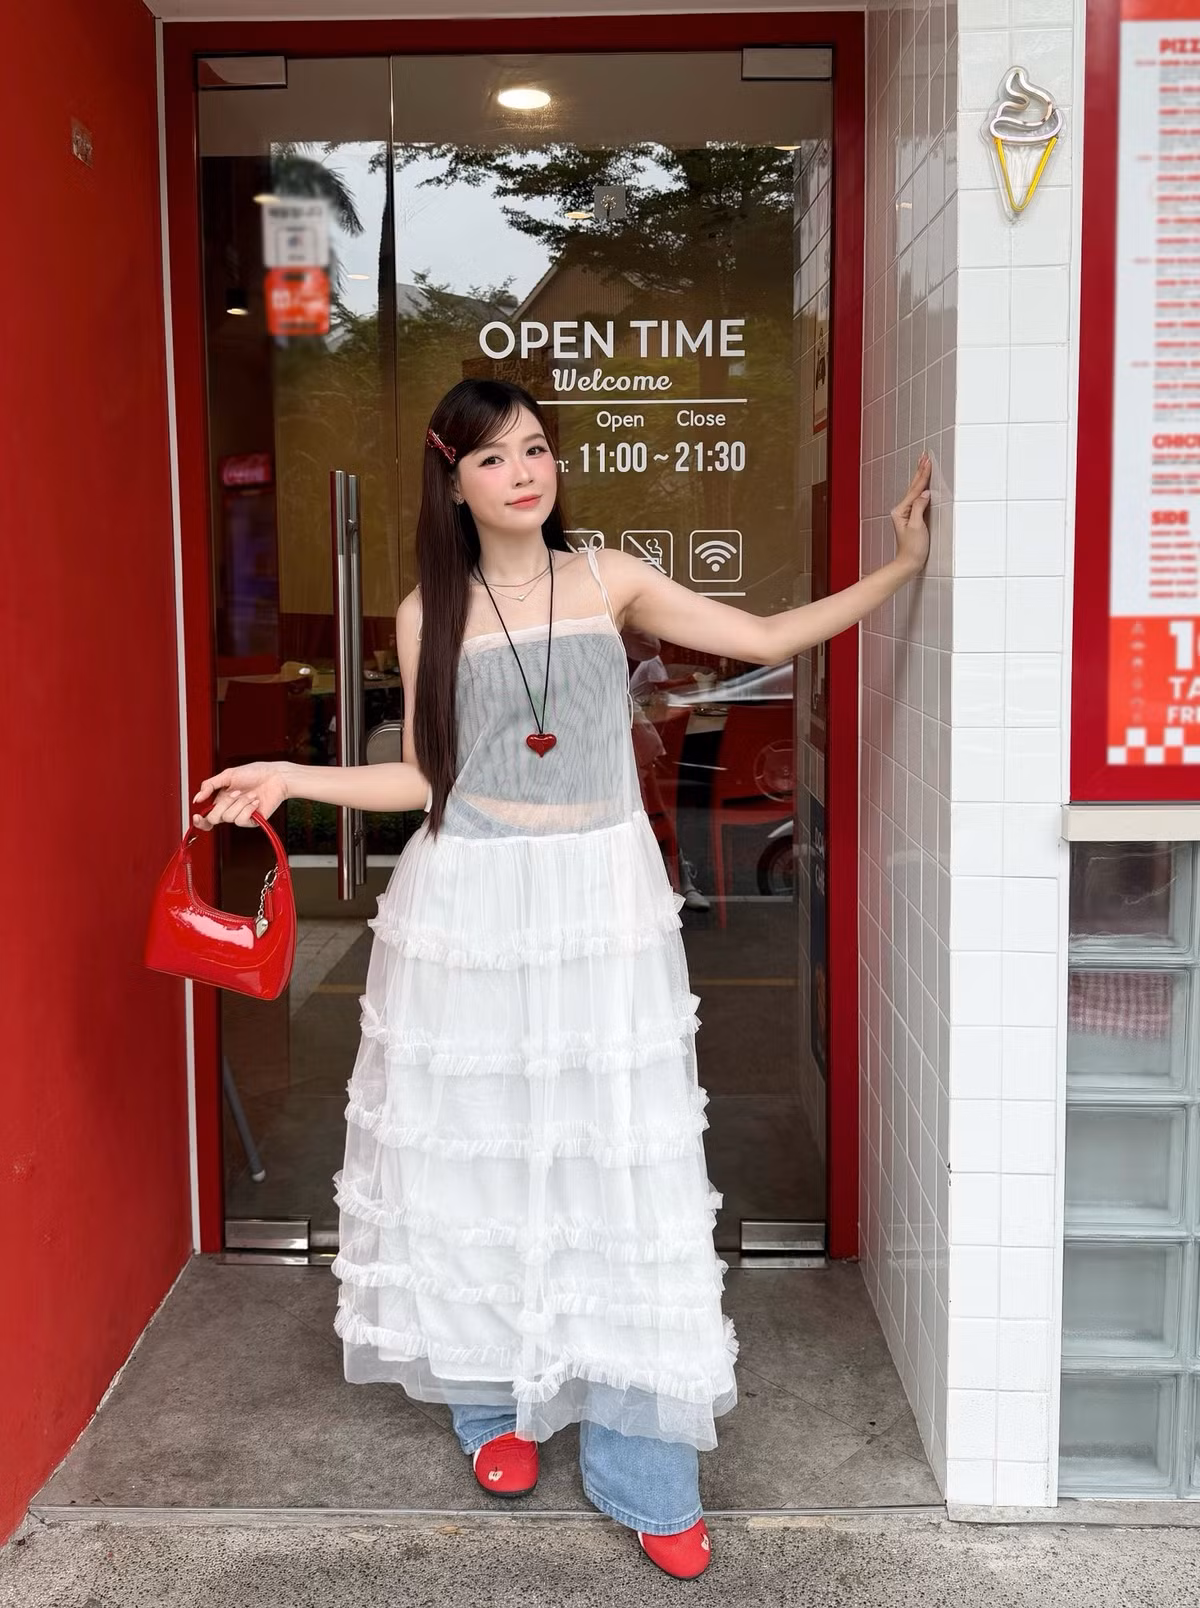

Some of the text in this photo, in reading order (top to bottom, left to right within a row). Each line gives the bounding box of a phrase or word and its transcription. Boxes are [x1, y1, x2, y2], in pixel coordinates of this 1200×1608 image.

[479, 320, 746, 359] OPEN TIME
[552, 369, 673, 392] Welcome
[597, 410, 726, 432] Open Close
[1152, 434, 1200, 449] CHIC
[580, 442, 647, 473] 11:00
[675, 441, 746, 472] 21:30
[1151, 510, 1188, 525] SIDE
[1169, 621, 1200, 670] 1
